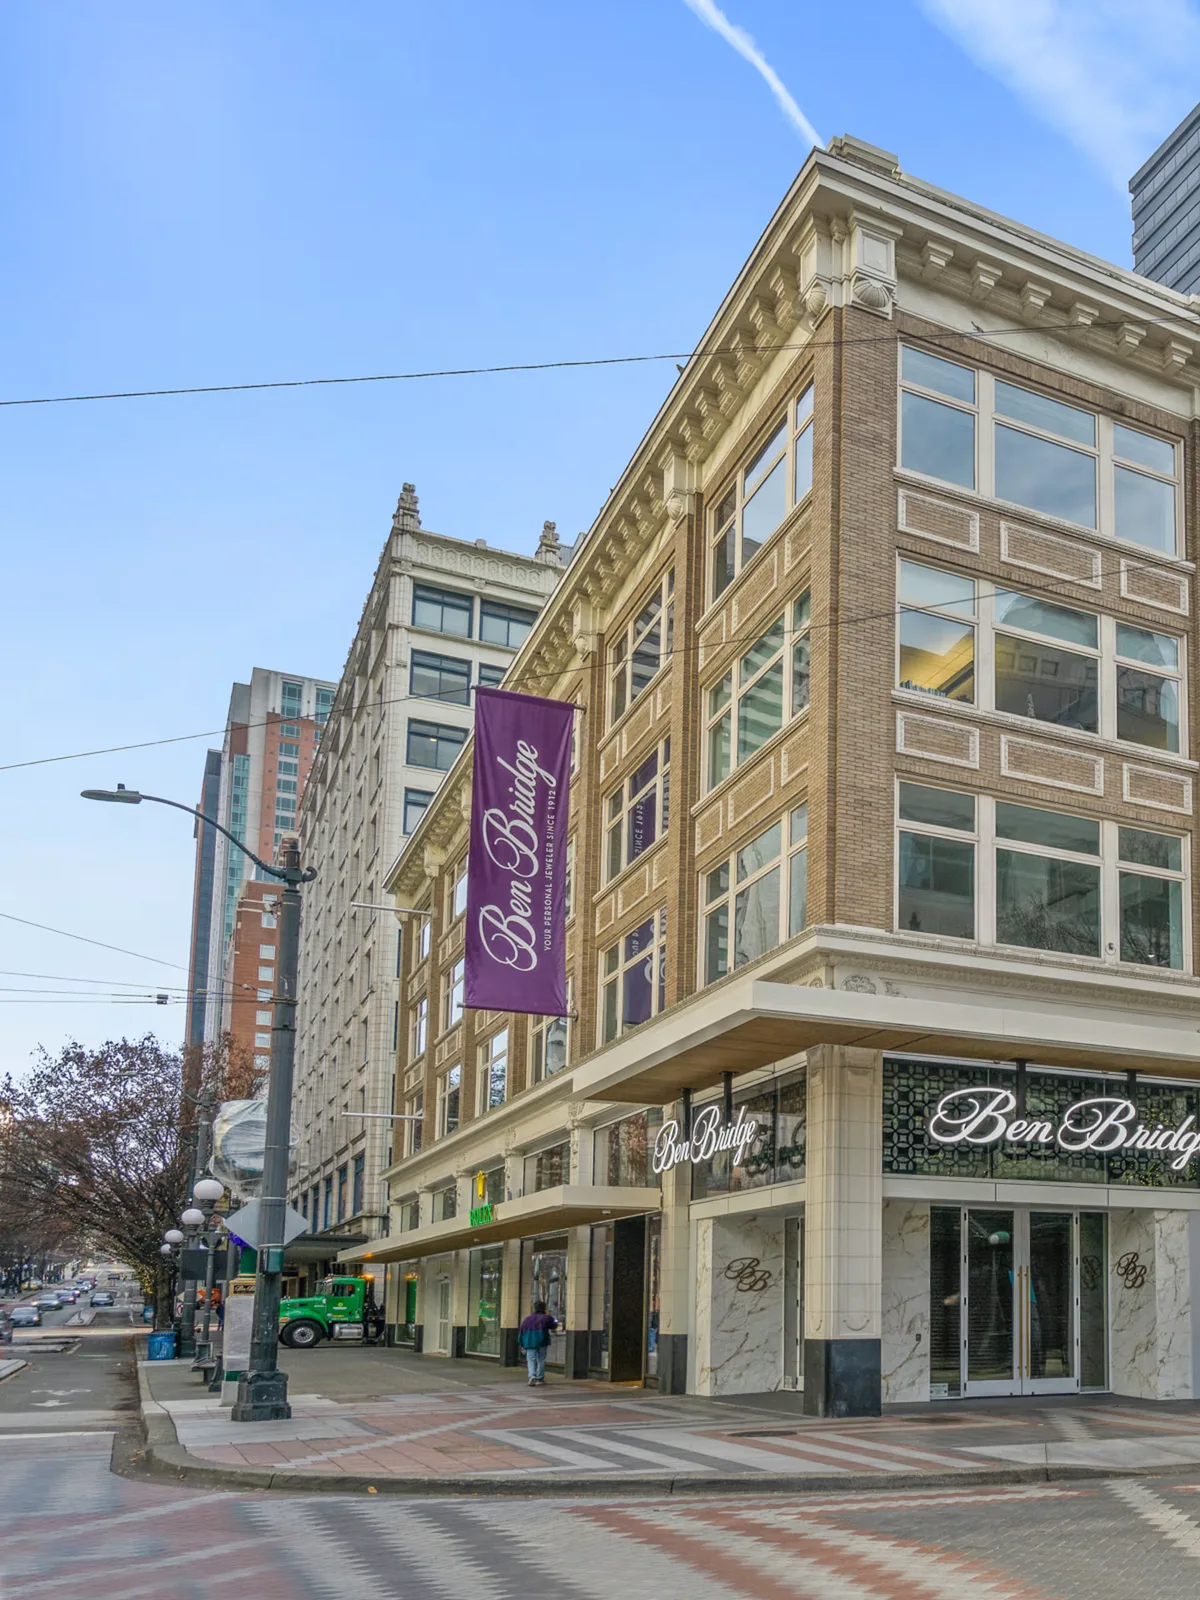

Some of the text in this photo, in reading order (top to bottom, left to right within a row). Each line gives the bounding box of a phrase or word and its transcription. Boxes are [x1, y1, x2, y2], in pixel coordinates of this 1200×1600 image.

[479, 739, 557, 972] Ben Bridge
[543, 790, 557, 951] YOUR PERSONAL JEWELER SINCE 1912
[652, 1104, 757, 1174] Ben Bridge
[929, 1087, 1053, 1144] Ben
[469, 1203, 493, 1228] ROLEX
